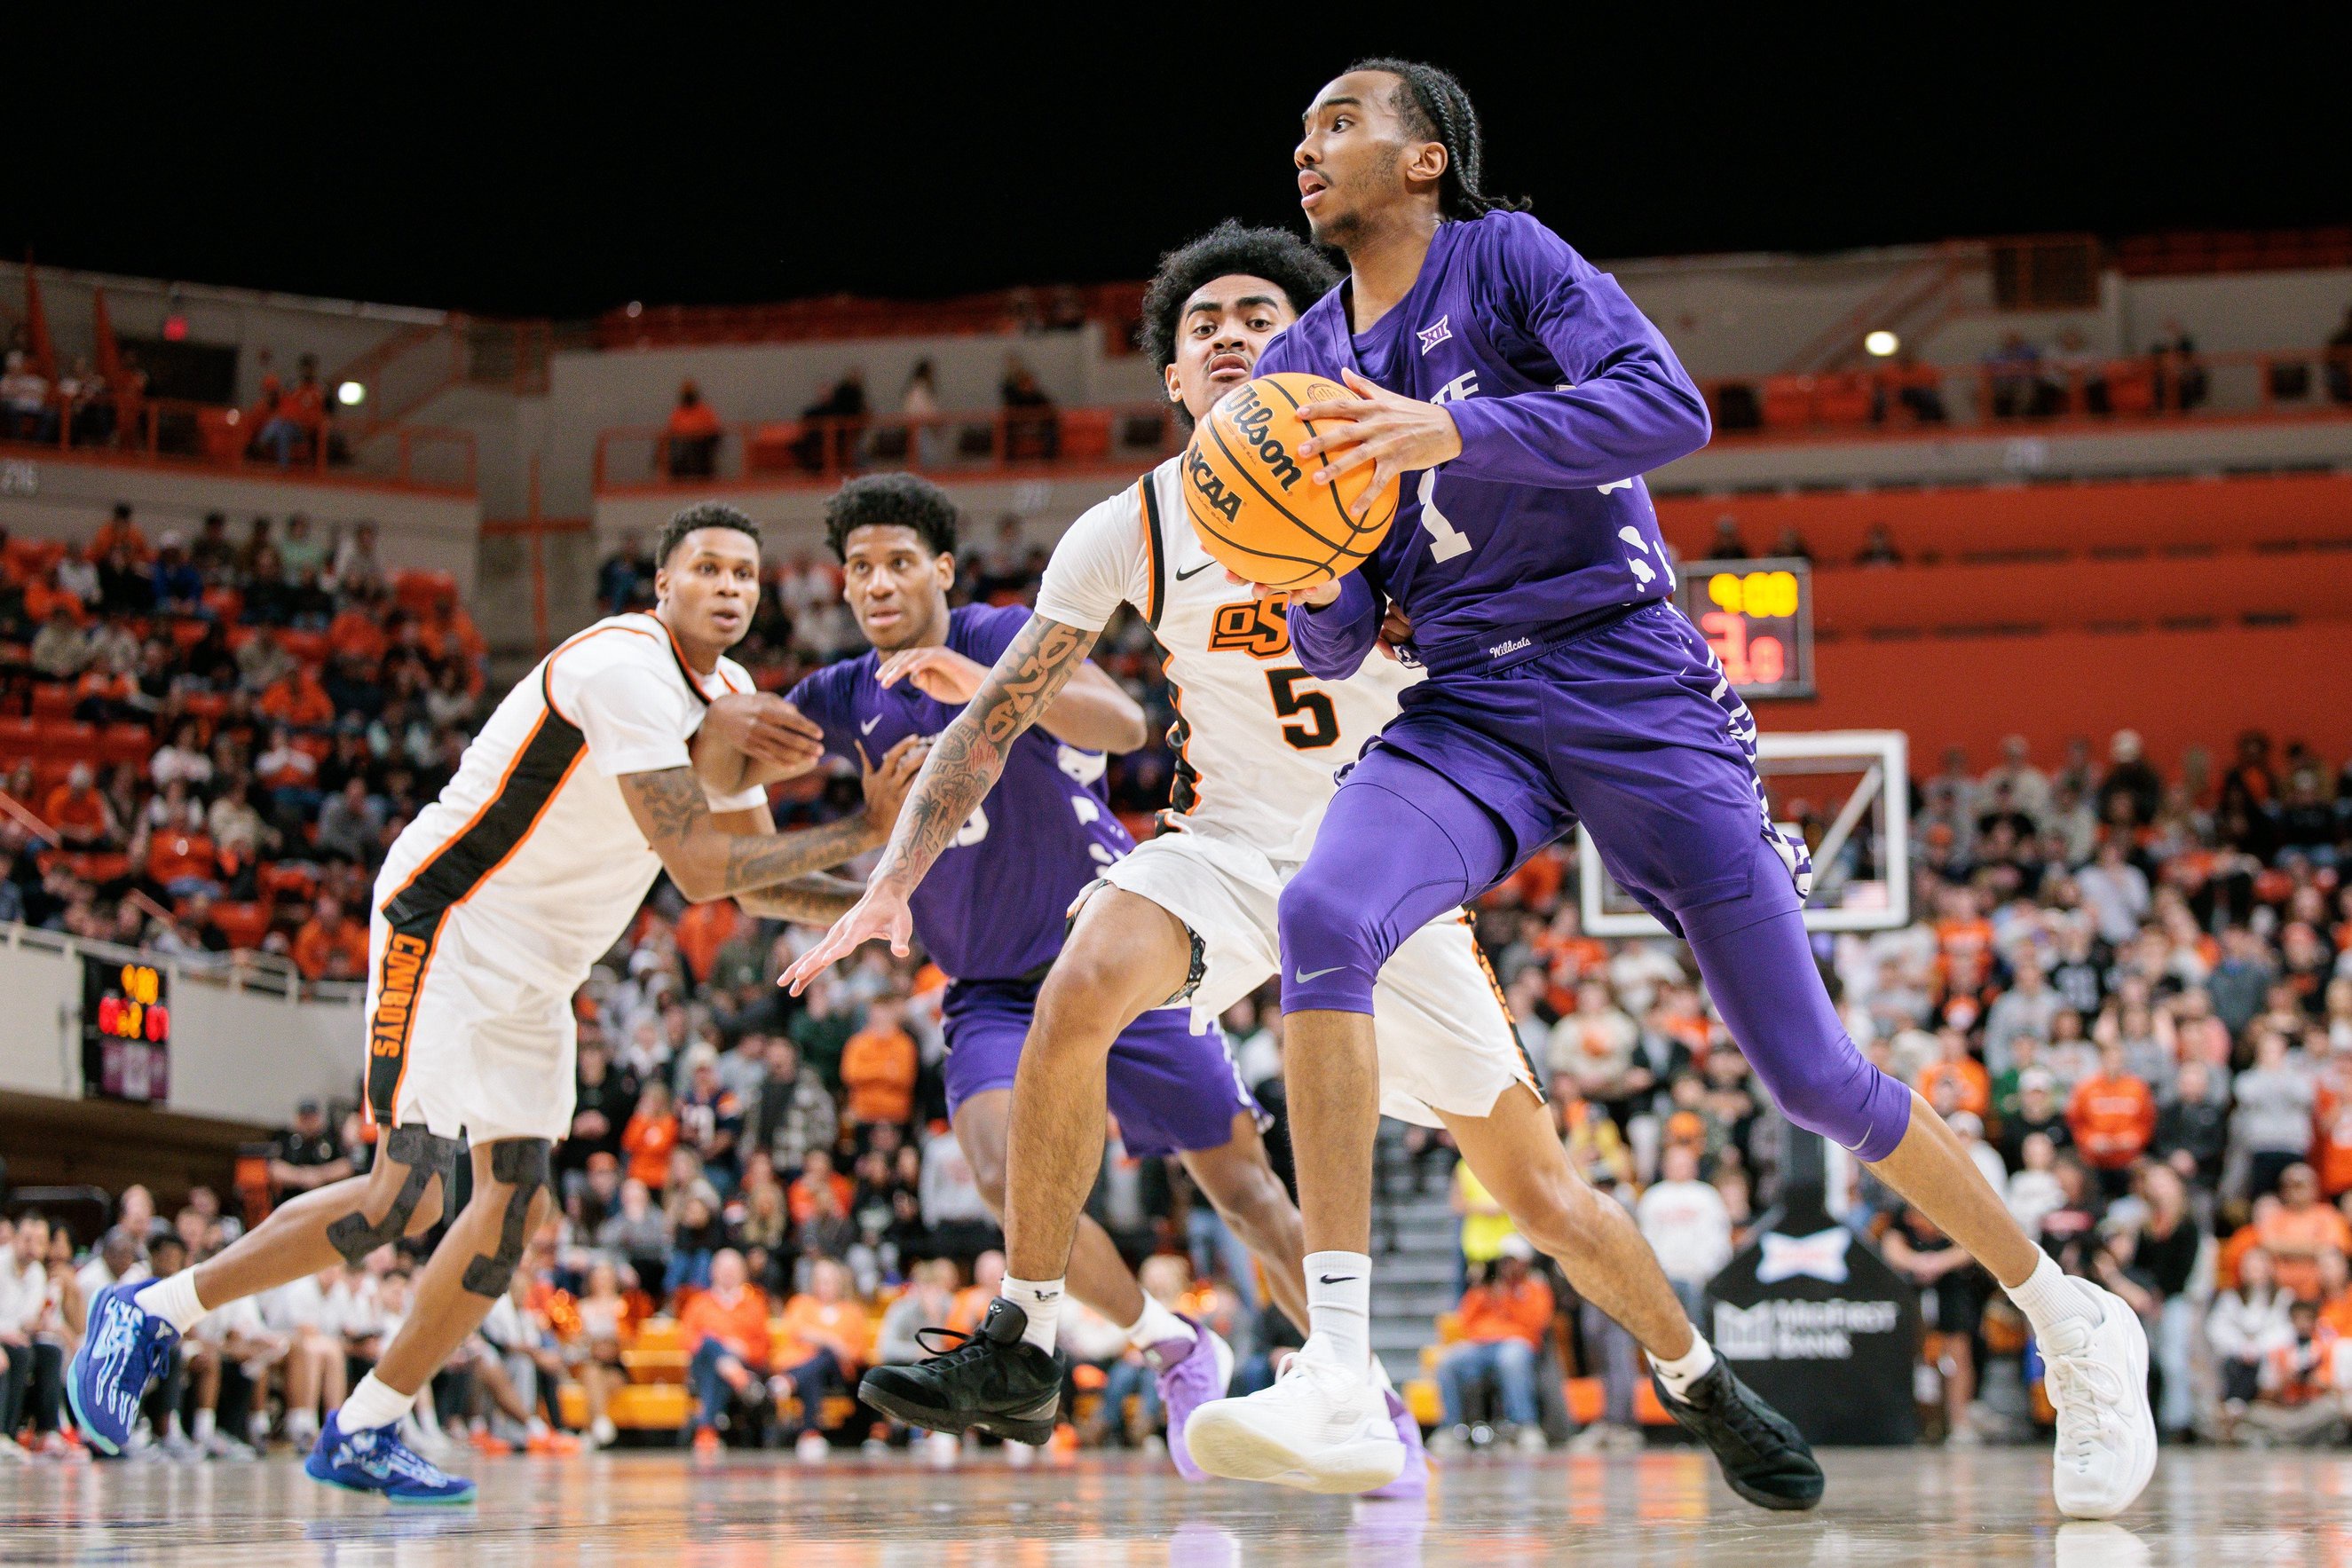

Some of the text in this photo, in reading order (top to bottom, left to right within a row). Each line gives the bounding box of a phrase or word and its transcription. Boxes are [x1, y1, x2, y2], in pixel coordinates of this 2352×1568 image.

[1222, 382, 1303, 492] Wilson
[1187, 441, 1243, 524] NCAA
[1489, 636, 1532, 658] Wildcats
[1264, 666, 1341, 751] 5
[373, 933, 427, 1059] COWBOYS
